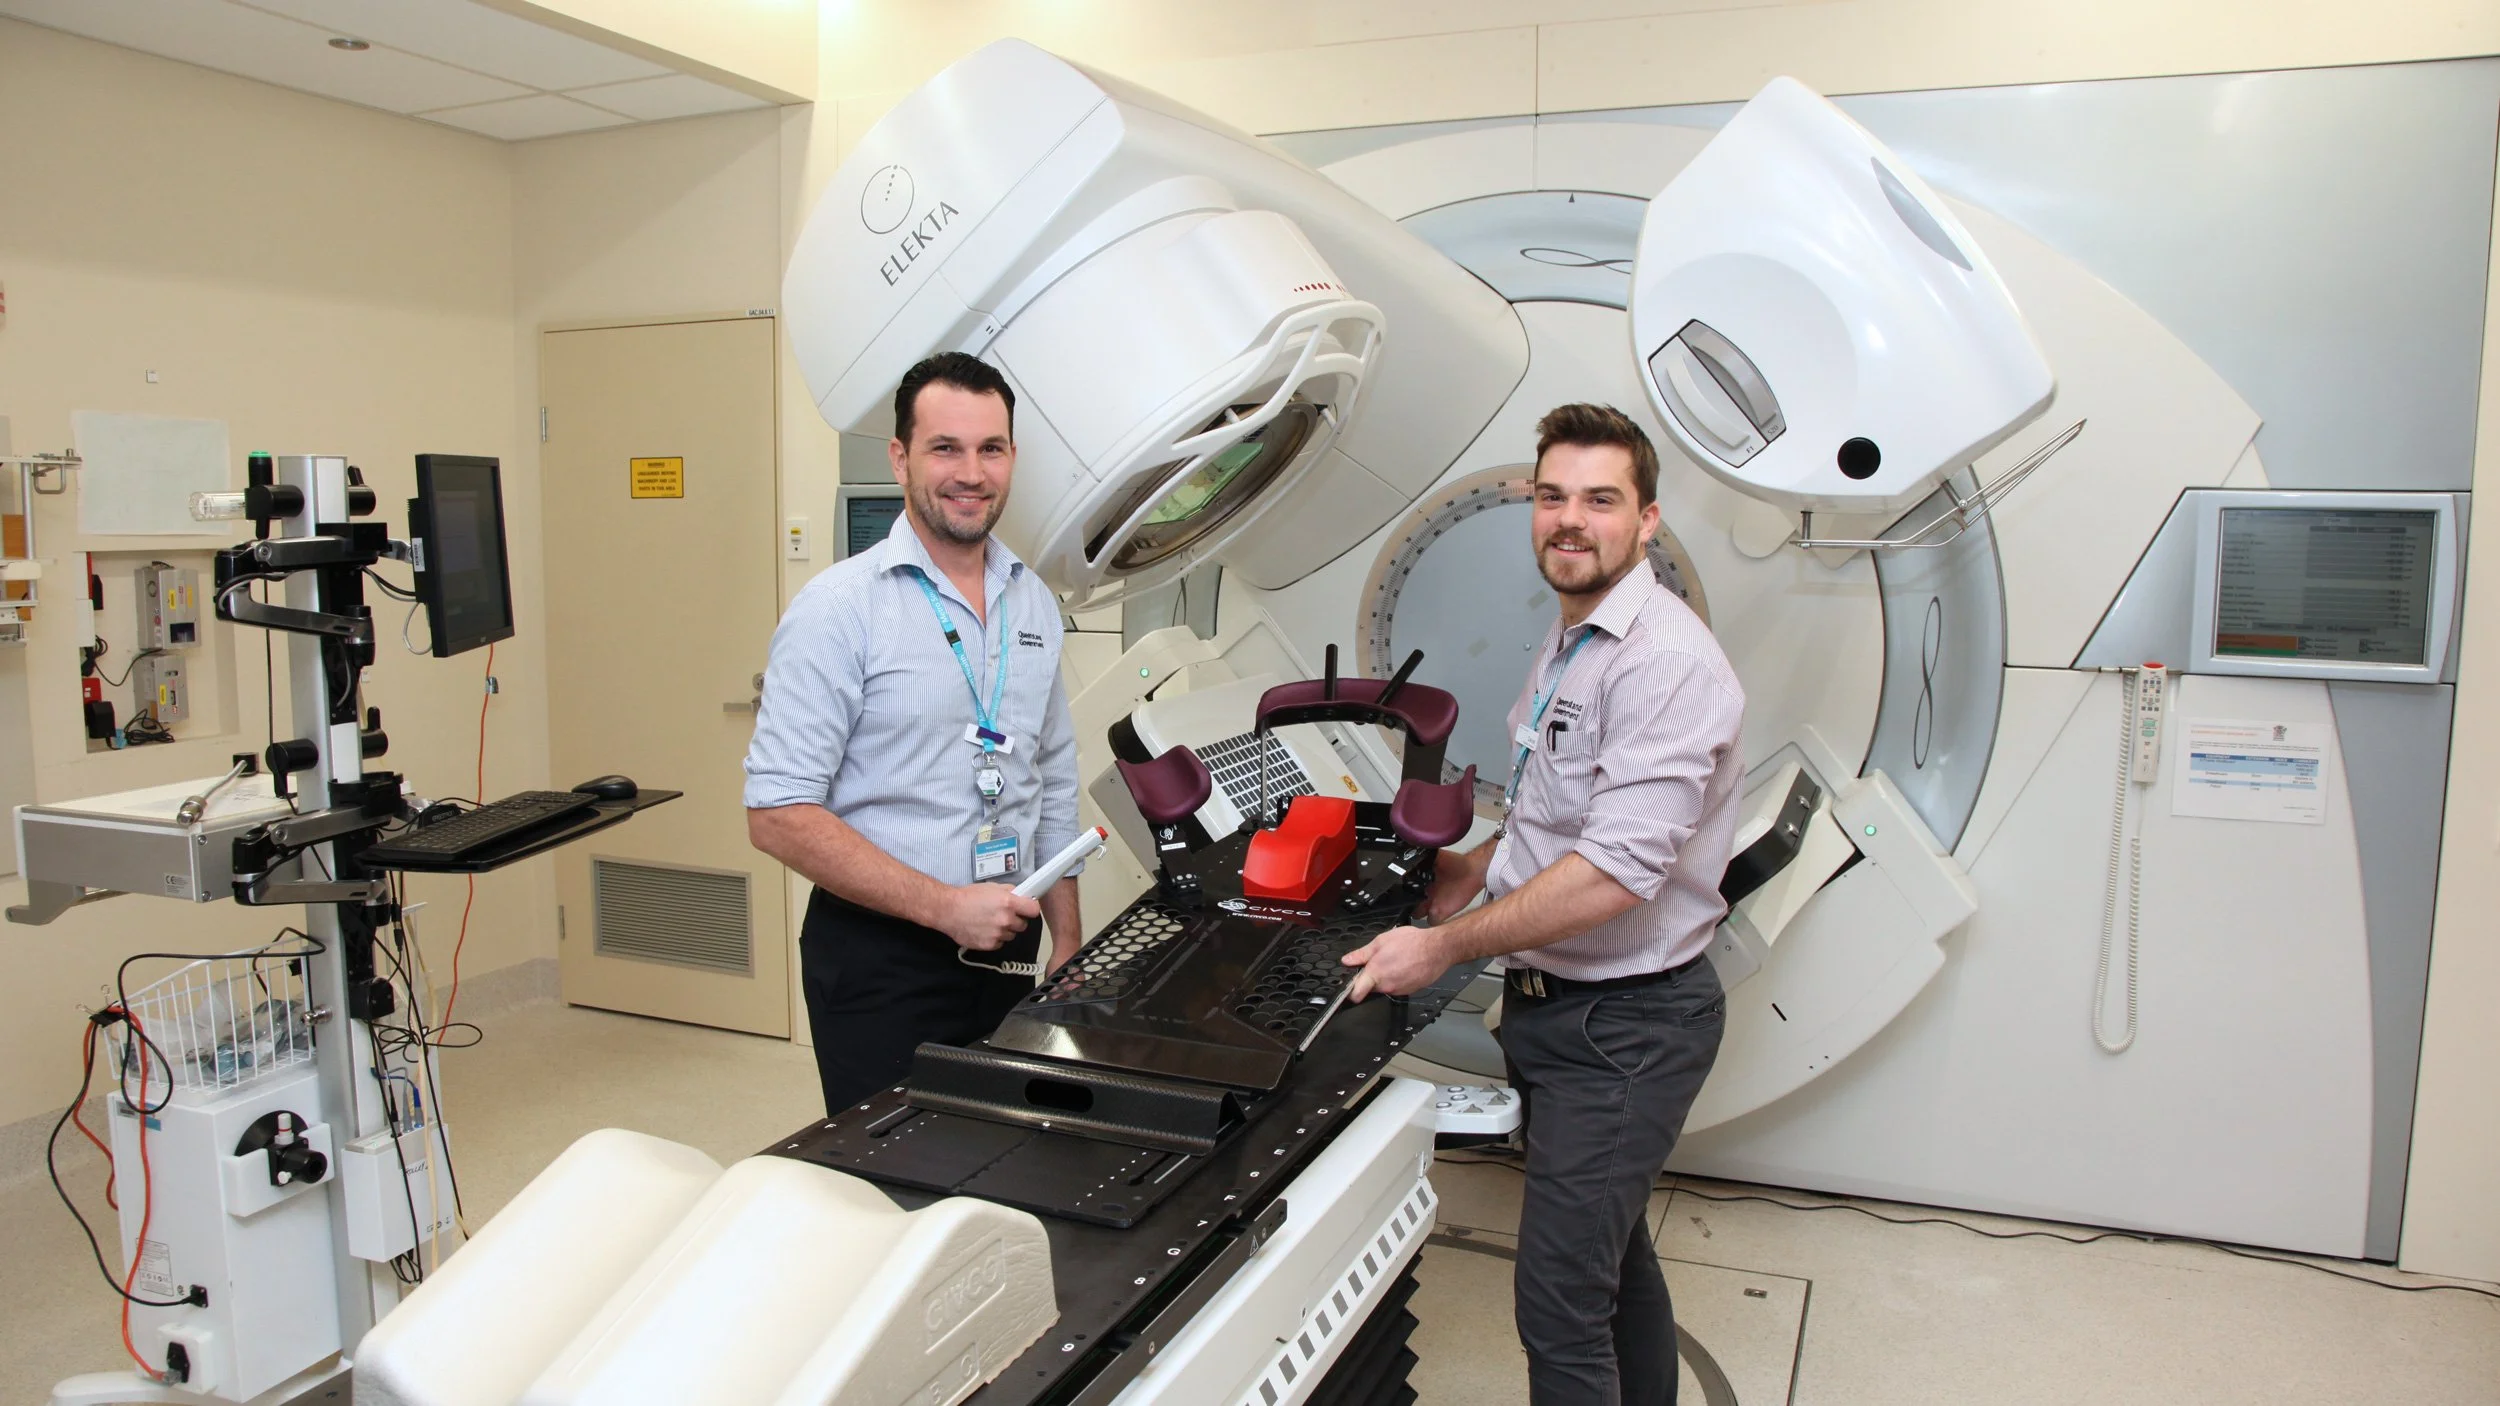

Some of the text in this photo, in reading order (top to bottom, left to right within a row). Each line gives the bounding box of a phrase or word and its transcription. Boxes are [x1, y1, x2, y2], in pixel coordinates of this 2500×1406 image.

[880, 201, 959, 286] ELEKTA
[1249, 906, 1312, 916] CIVCO
[1167, 1248, 1181, 1256] G
[1134, 1277, 1146, 1285] 8
[1062, 1343, 1075, 1352] 9
